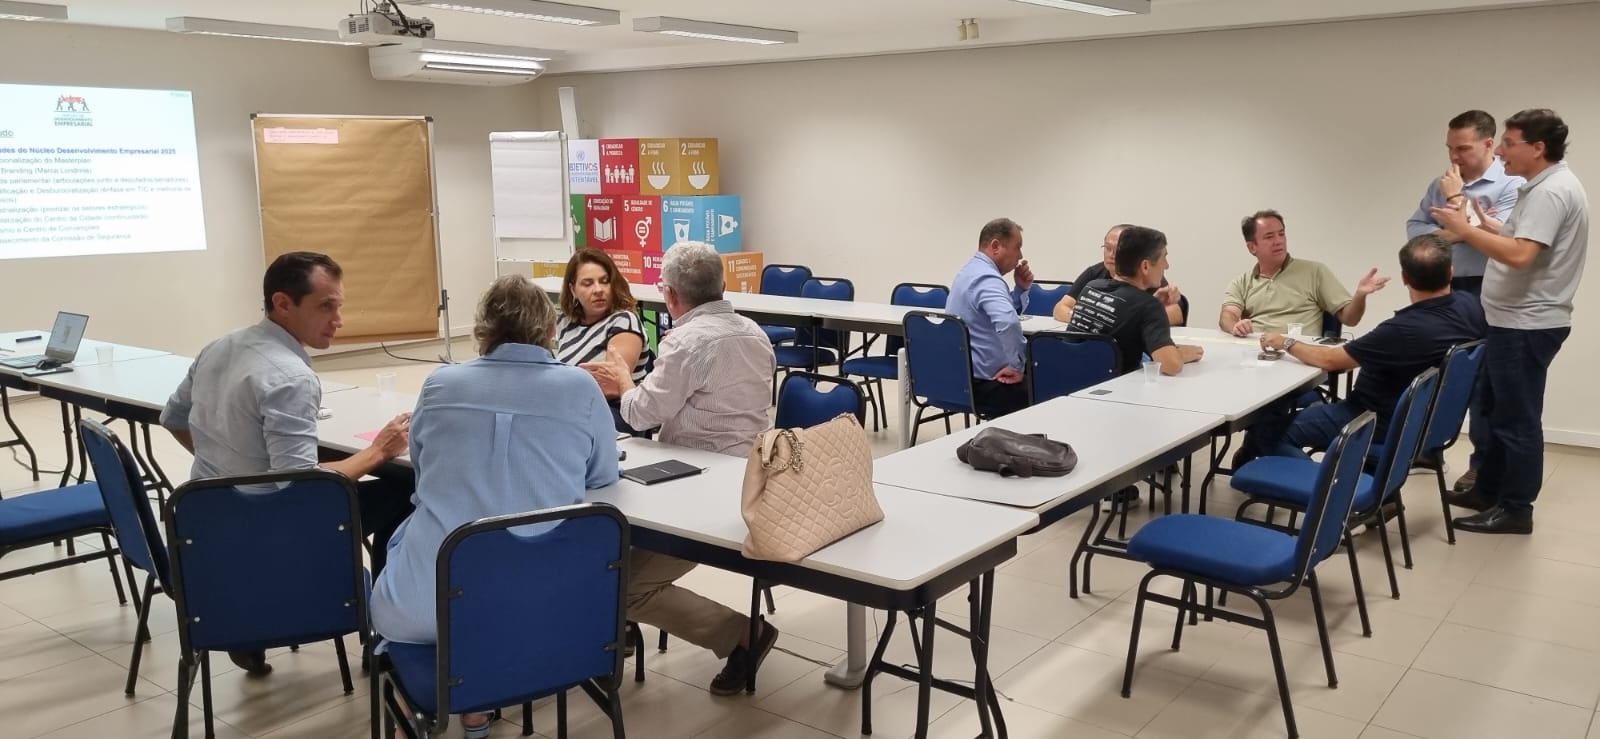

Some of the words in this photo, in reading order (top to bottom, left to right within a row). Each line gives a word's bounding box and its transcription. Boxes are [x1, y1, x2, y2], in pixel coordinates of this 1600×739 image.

[601, 144, 606, 156] 1
[641, 143, 646, 156] 2
[681, 143, 686, 156] 2
[54, 157, 91, 165] Masterplan
[588, 198, 592, 210] 4
[624, 200, 630, 212] 5
[663, 200, 668, 212] 6
[644, 256, 652, 268] 10
[728, 260, 734, 272] 11
[660, 312, 669, 325] 16
